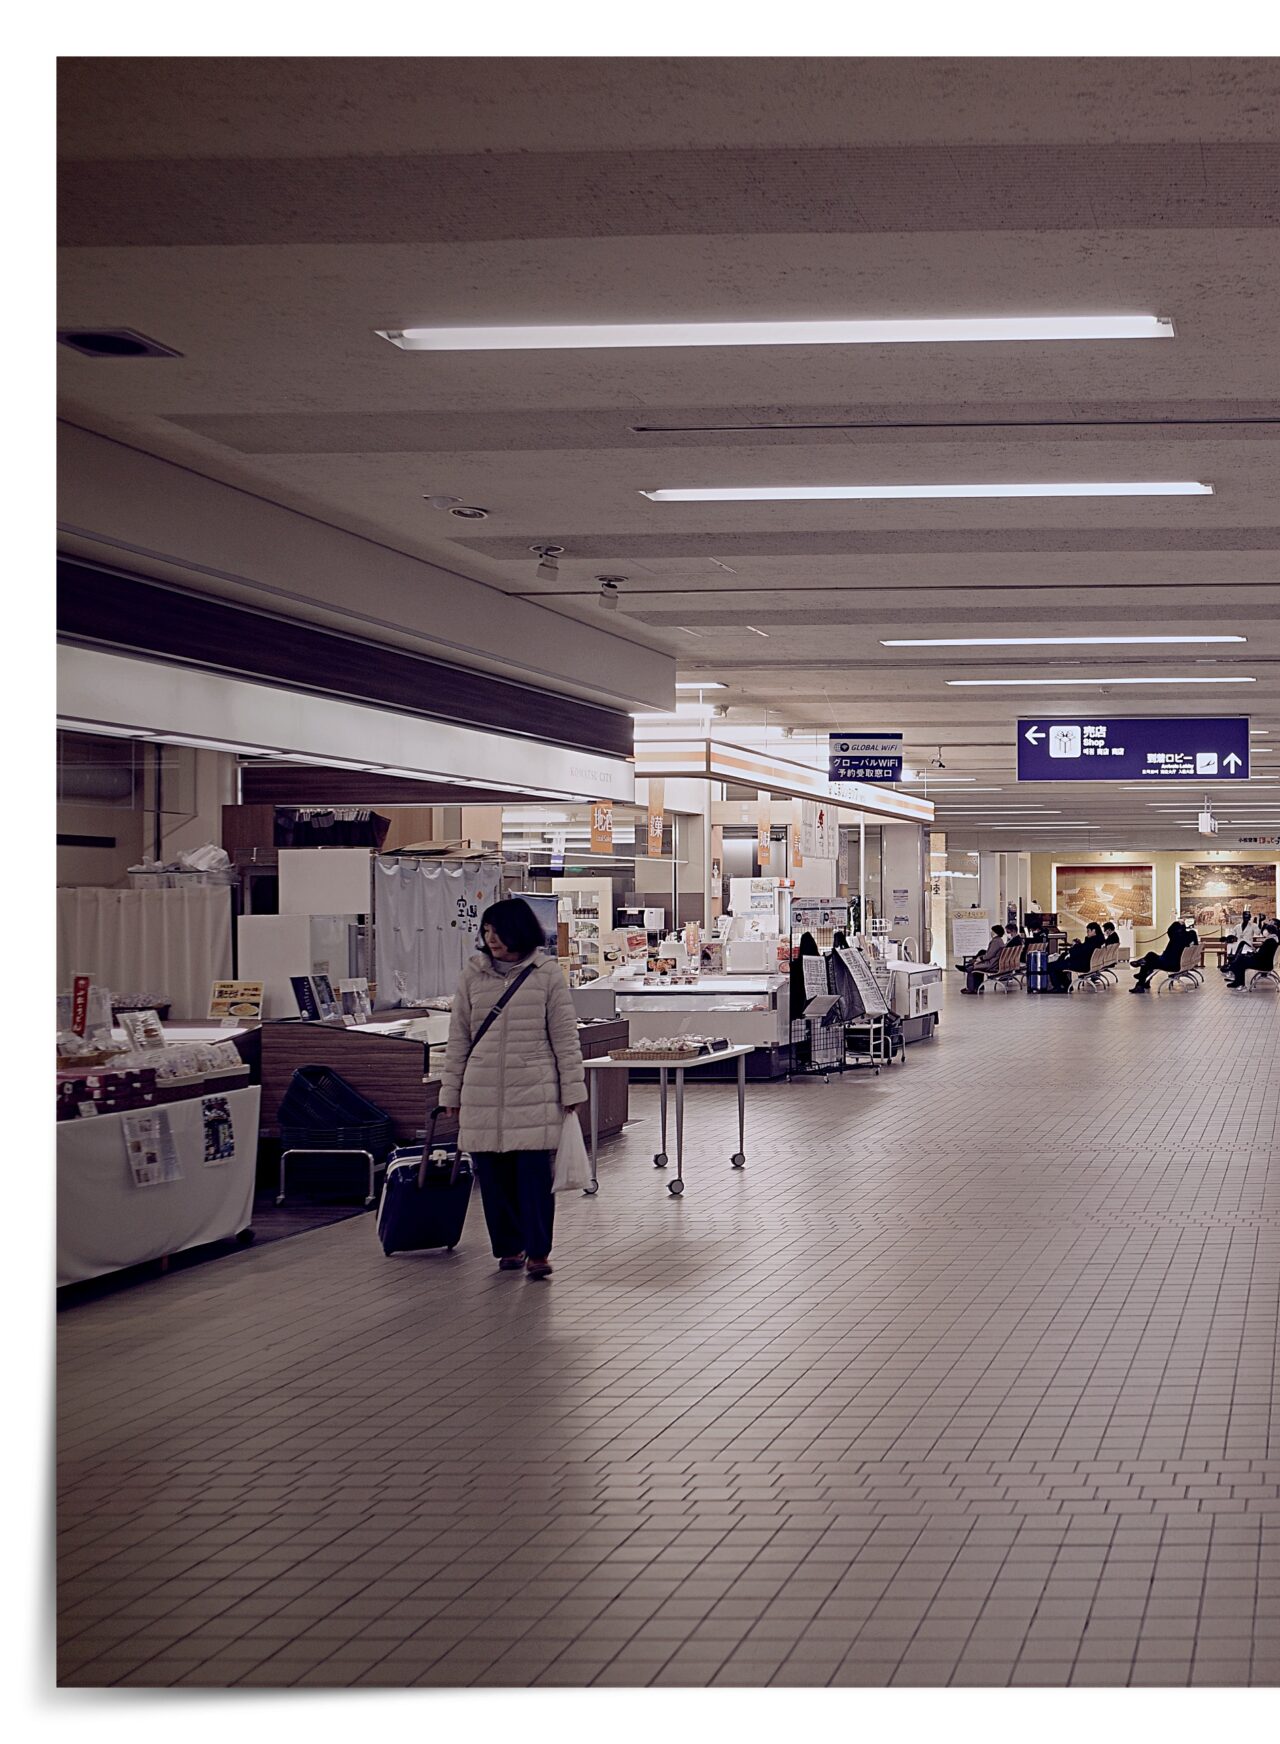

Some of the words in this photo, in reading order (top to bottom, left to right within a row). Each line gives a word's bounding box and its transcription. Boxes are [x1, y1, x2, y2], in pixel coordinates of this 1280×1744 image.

[1083, 739, 1105, 747] Shop
[833, 758, 898, 767] グローバルWiFi
[1147, 753, 1192, 763] 到着ロビー
[570, 767, 597, 781] KOMATSU
[599, 772, 613, 783] CITY
[838, 768, 892, 778] 予約受取窓口
[594, 806, 613, 831] 地酒
